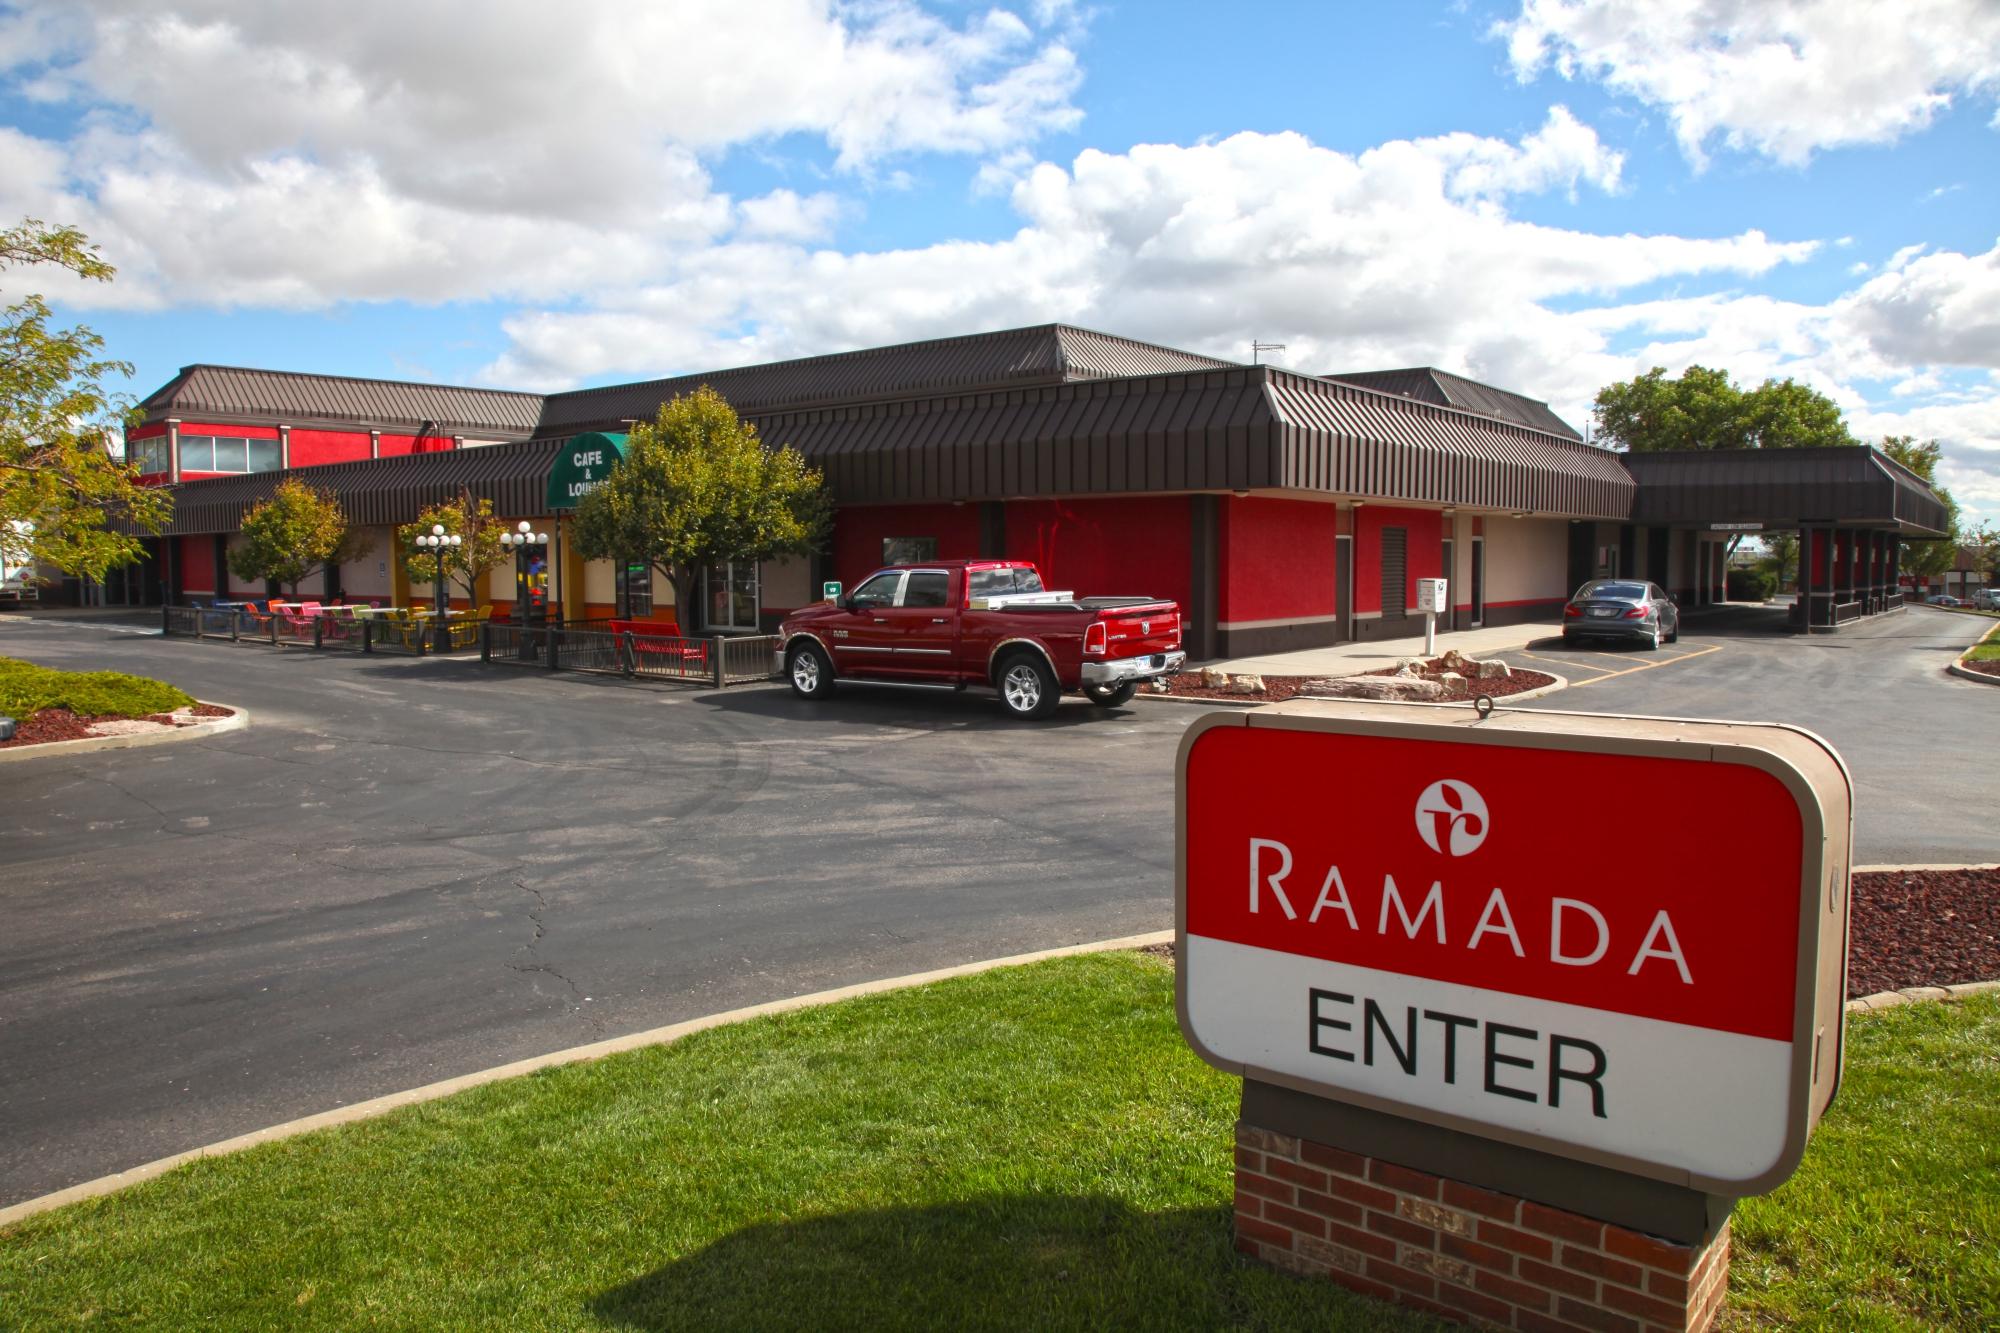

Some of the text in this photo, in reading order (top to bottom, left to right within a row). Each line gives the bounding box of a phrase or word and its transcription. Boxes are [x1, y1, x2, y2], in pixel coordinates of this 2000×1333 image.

[573, 450, 603, 467] CAFE
[585, 468, 592, 480] &
[1249, 837, 1694, 984] RAMADA
[1308, 987, 1608, 1119] ENTER
